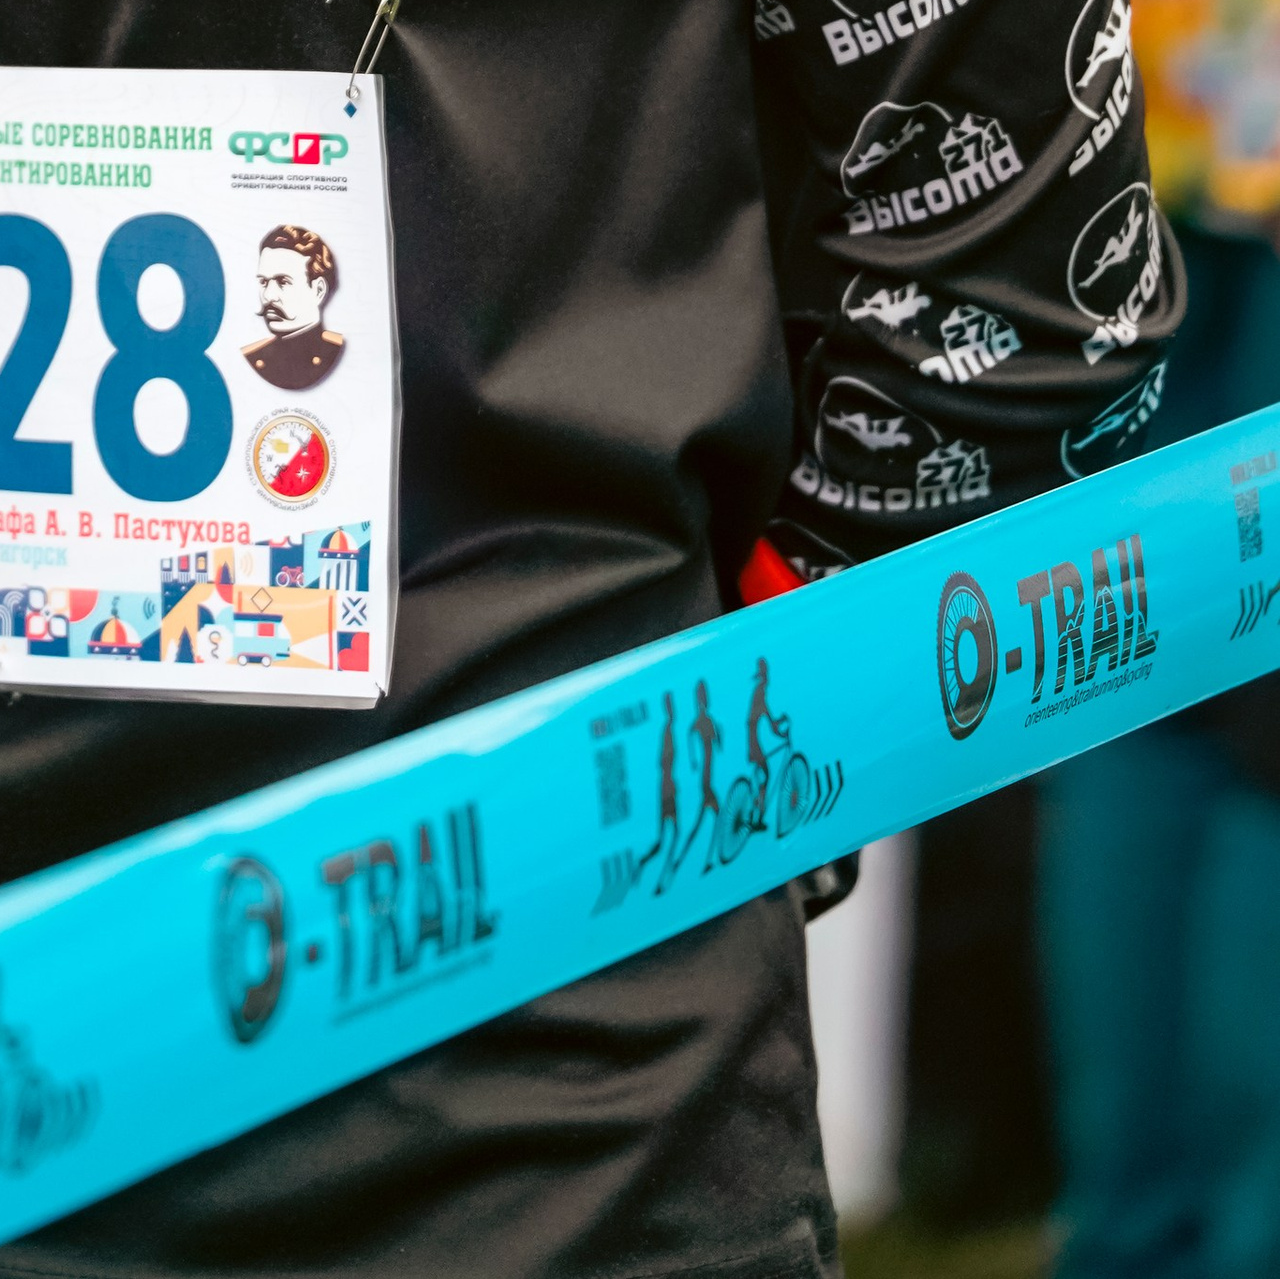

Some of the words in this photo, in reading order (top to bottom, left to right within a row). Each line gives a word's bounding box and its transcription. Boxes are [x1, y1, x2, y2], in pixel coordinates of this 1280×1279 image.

[32, 122, 213, 151] СОРЕВНОВАНИЯ
[942, 123, 1008, 175] 271
[231, 173, 284, 182] ФЕДЕРАЦИЯ
[286, 174, 348, 183] СПОРТИВНОГО
[231, 182, 311, 191] ОРИЕНТИРОВАНИЯ
[313, 184, 348, 192] РОССИИ
[920, 452, 986, 487] 271
[44, 509, 68, 537] А.
[77, 511, 102, 538] В.
[113, 512, 251, 548] Пастухова
